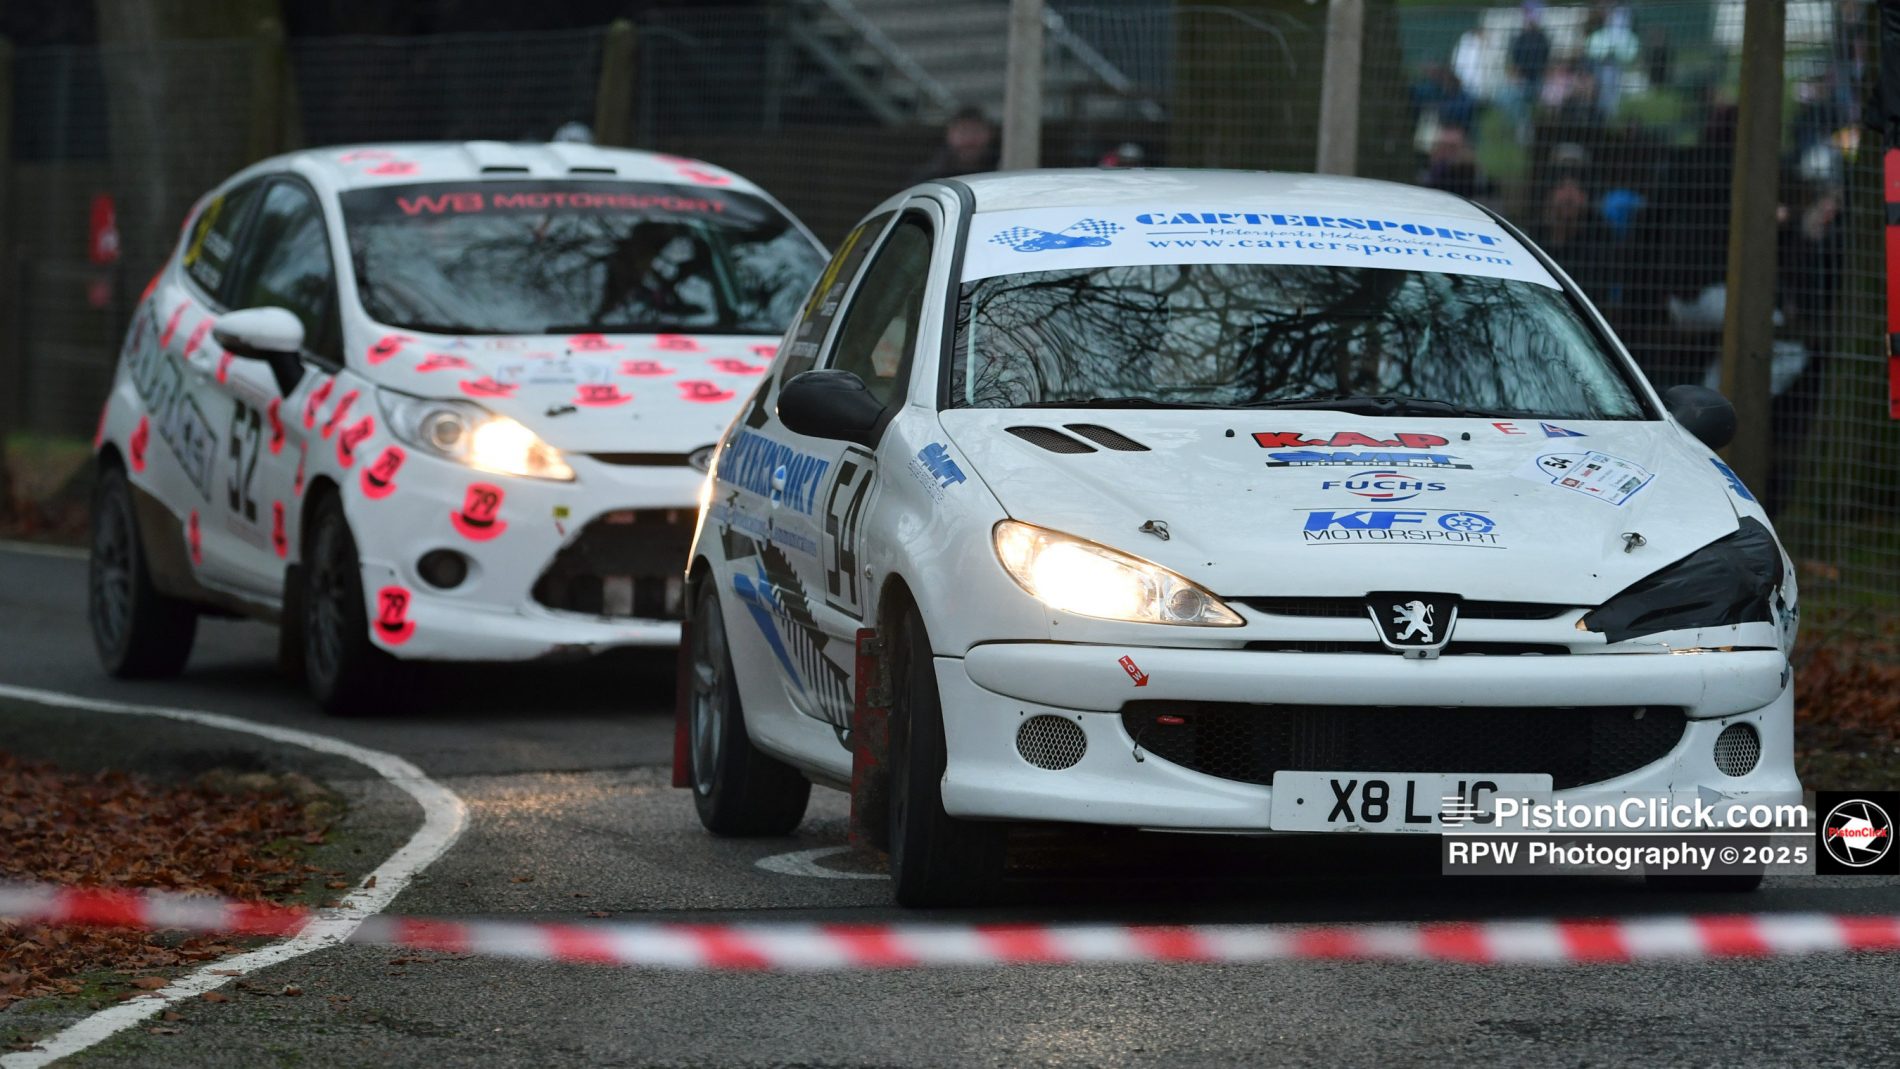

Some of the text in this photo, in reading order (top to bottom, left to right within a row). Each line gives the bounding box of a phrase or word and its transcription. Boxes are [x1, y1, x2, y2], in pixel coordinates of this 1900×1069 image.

[395, 192, 726, 215] WB MOTORSPORT
[1136, 213, 1502, 246] CARTERSPORT
[1210, 228, 1441, 248] Motorsports Media Services
[1147, 239, 1513, 267] www.cartersport.com
[228, 398, 262, 523] 52
[1543, 456, 1573, 469] 54
[1322, 480, 1446, 491] FUCHS
[470, 488, 498, 516] 79
[826, 460, 873, 605] 54
[1304, 511, 1427, 531] KF
[1303, 529, 1499, 545] MOTORSPORT
[382, 592, 406, 617] 79
[1121, 657, 1143, 681] TOW
[1327, 779, 1498, 824] X8 LJC
